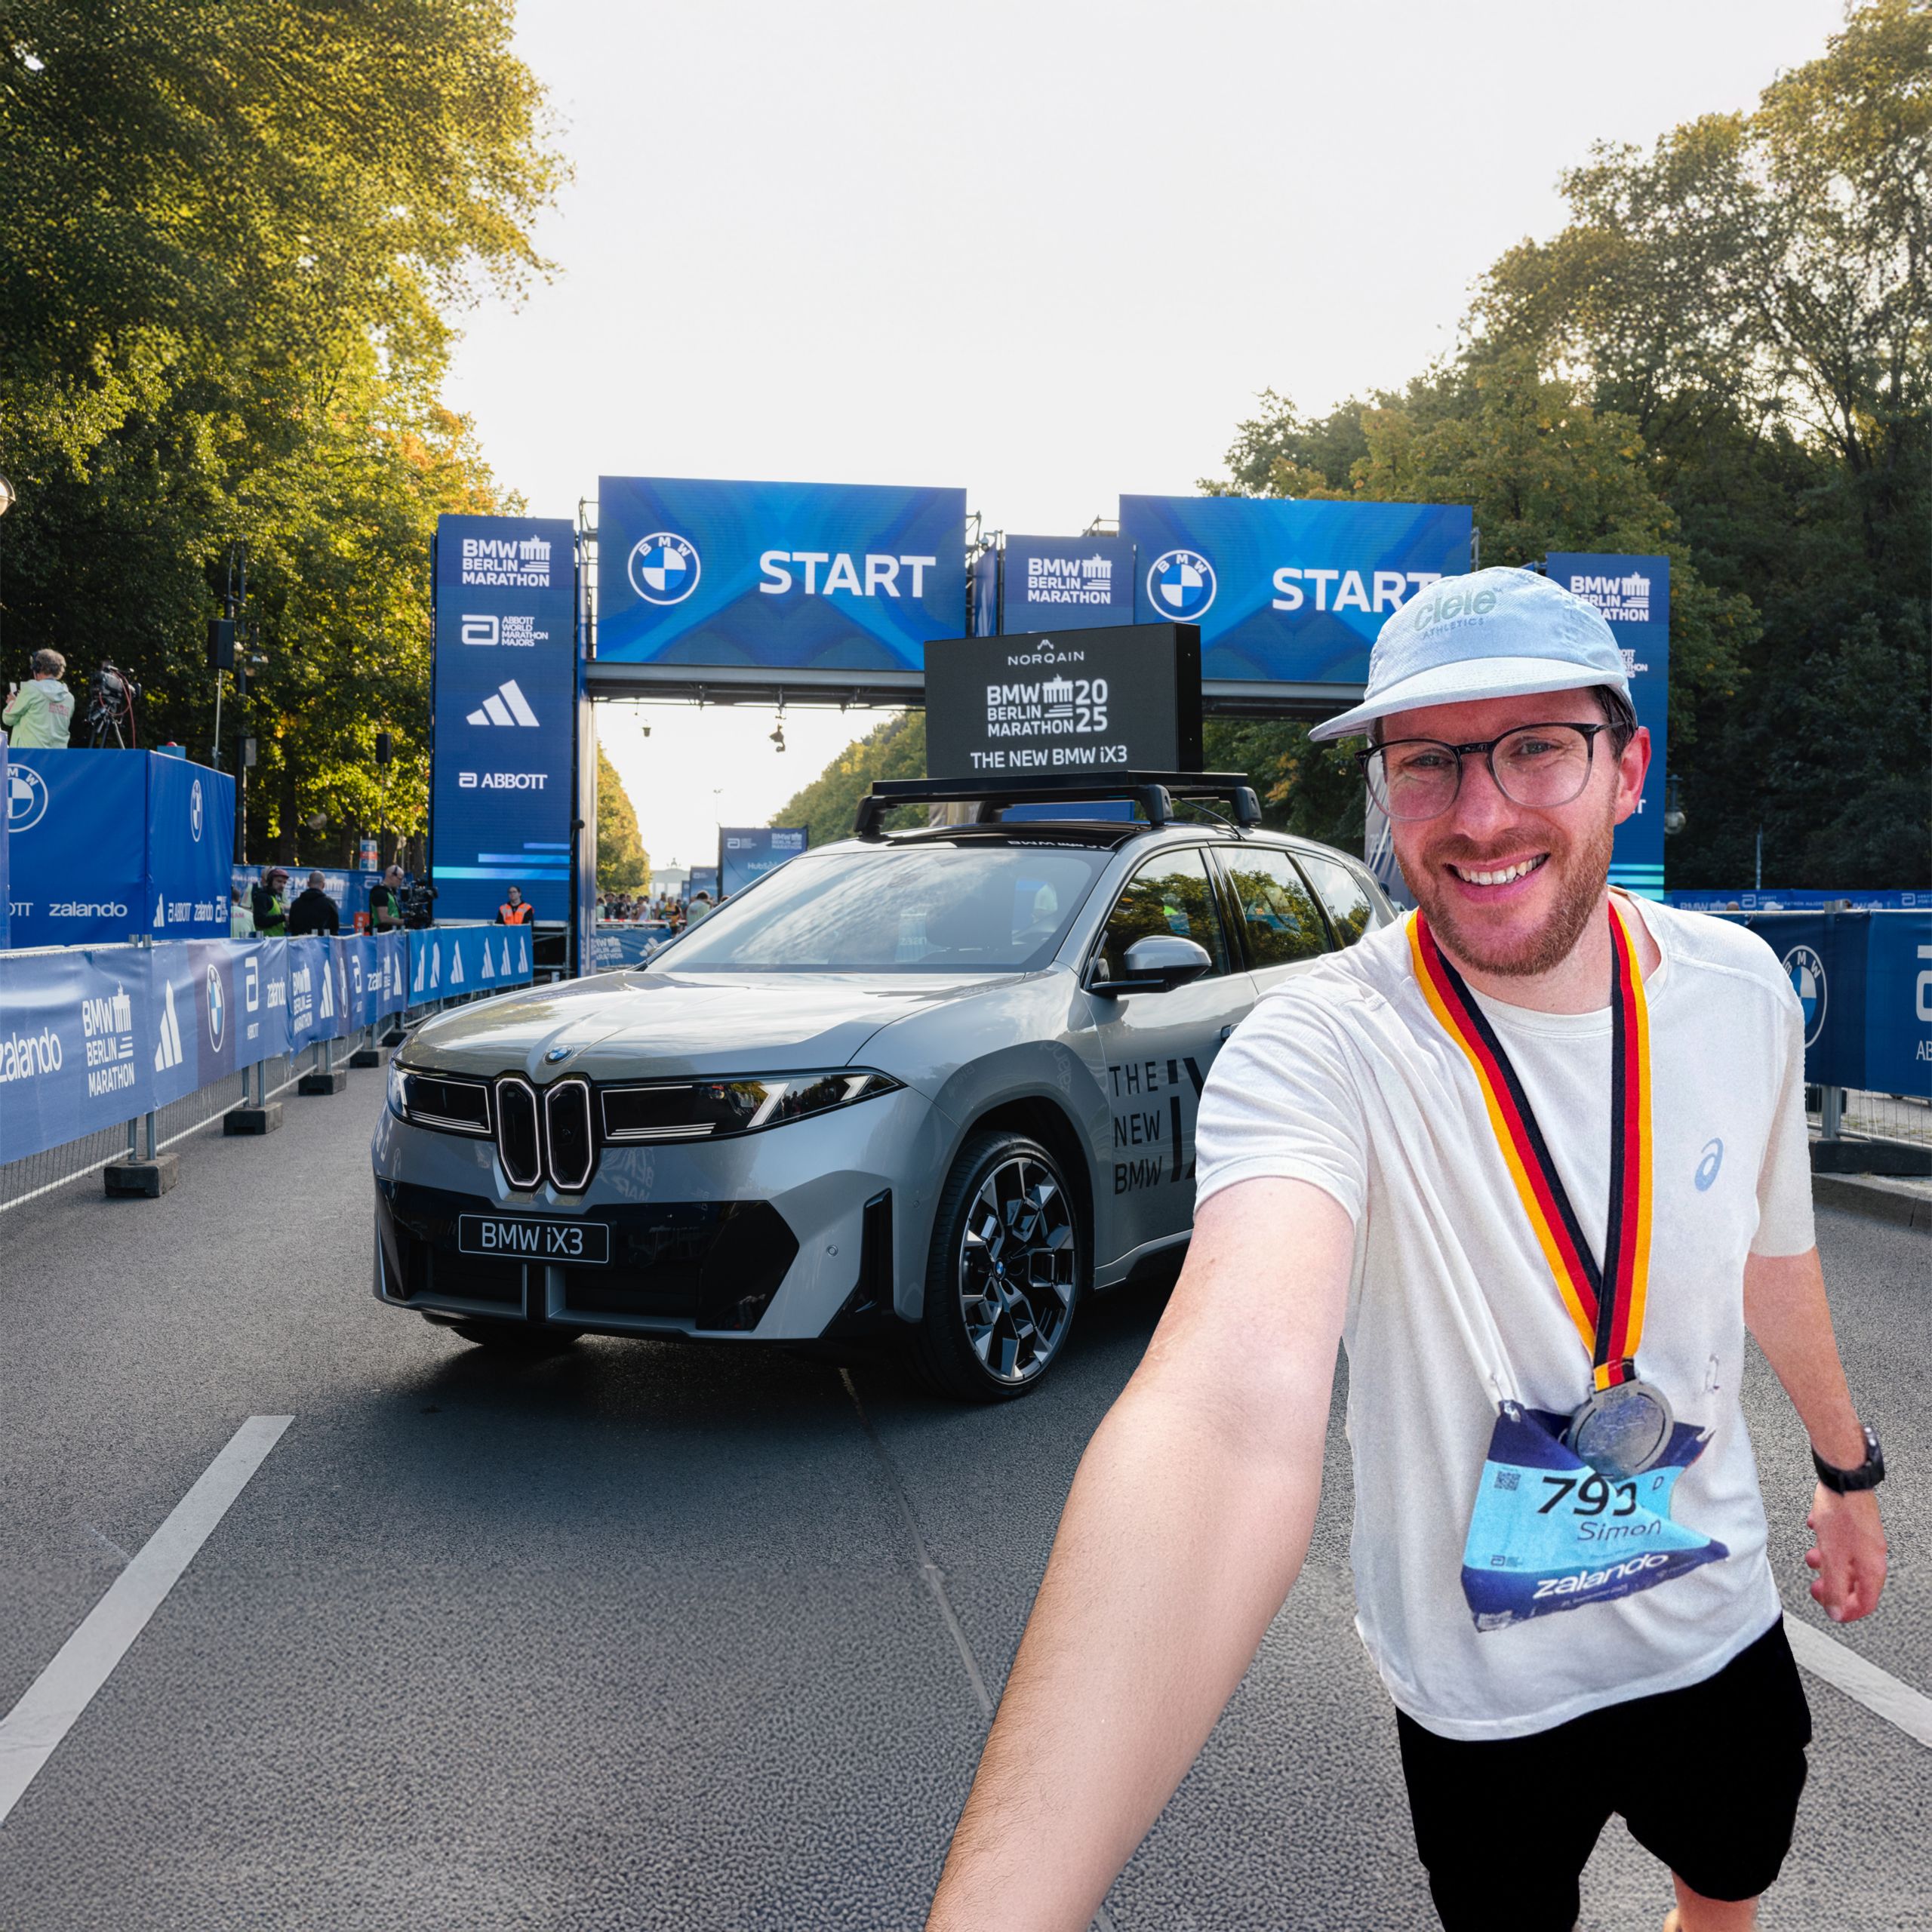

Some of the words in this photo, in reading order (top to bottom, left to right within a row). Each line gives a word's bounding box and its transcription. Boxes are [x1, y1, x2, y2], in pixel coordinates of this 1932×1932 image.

[463, 539, 518, 558] BMW
[638, 537, 691, 556] BMW
[463, 558, 518, 571] BERLIN
[1028, 558, 1081, 577] BMW
[1157, 554, 1208, 574] BMW
[462, 571, 549, 587] MARATHON
[759, 551, 936, 598] START
[1028, 576, 1081, 589] BERLIN
[1571, 576, 1620, 594] BMW
[1028, 590, 1111, 604] MARATHON
[502, 616, 535, 625] ABBOTT
[1422, 617, 1484, 640] ATHLETICS
[501, 631, 549, 640] MARATHON
[501, 638, 534, 647] MAJORS
[1008, 651, 1084, 666] NORQAIN
[987, 683, 1040, 706] BMW
[1075, 678, 1108, 706] 20
[988, 704, 1041, 721] BERLIN
[1075, 706, 1108, 733] 25
[988, 719, 1074, 737] MARATHON
[971, 751, 1005, 768] THE
[1010, 749, 1048, 768] NEW
[1052, 747, 1096, 766] BMW
[1100, 745, 1128, 763] iX3
[481, 773, 548, 789] ABBOTT
[49, 902, 128, 917] zalando
[82, 997, 113, 1038] BMW
[86, 1036, 117, 1067] BERLIN
[88, 1063, 134, 1097] MARATHON
[1109, 1060, 1158, 1097] THE
[1114, 1110, 1160, 1148] NEW
[1115, 1155, 1162, 1195] BMW
[481, 1222, 540, 1252] BMW
[546, 1226, 583, 1255] iX3
[1577, 1519, 1661, 1541] Simon
[1532, 1553, 1669, 1600] zalando
